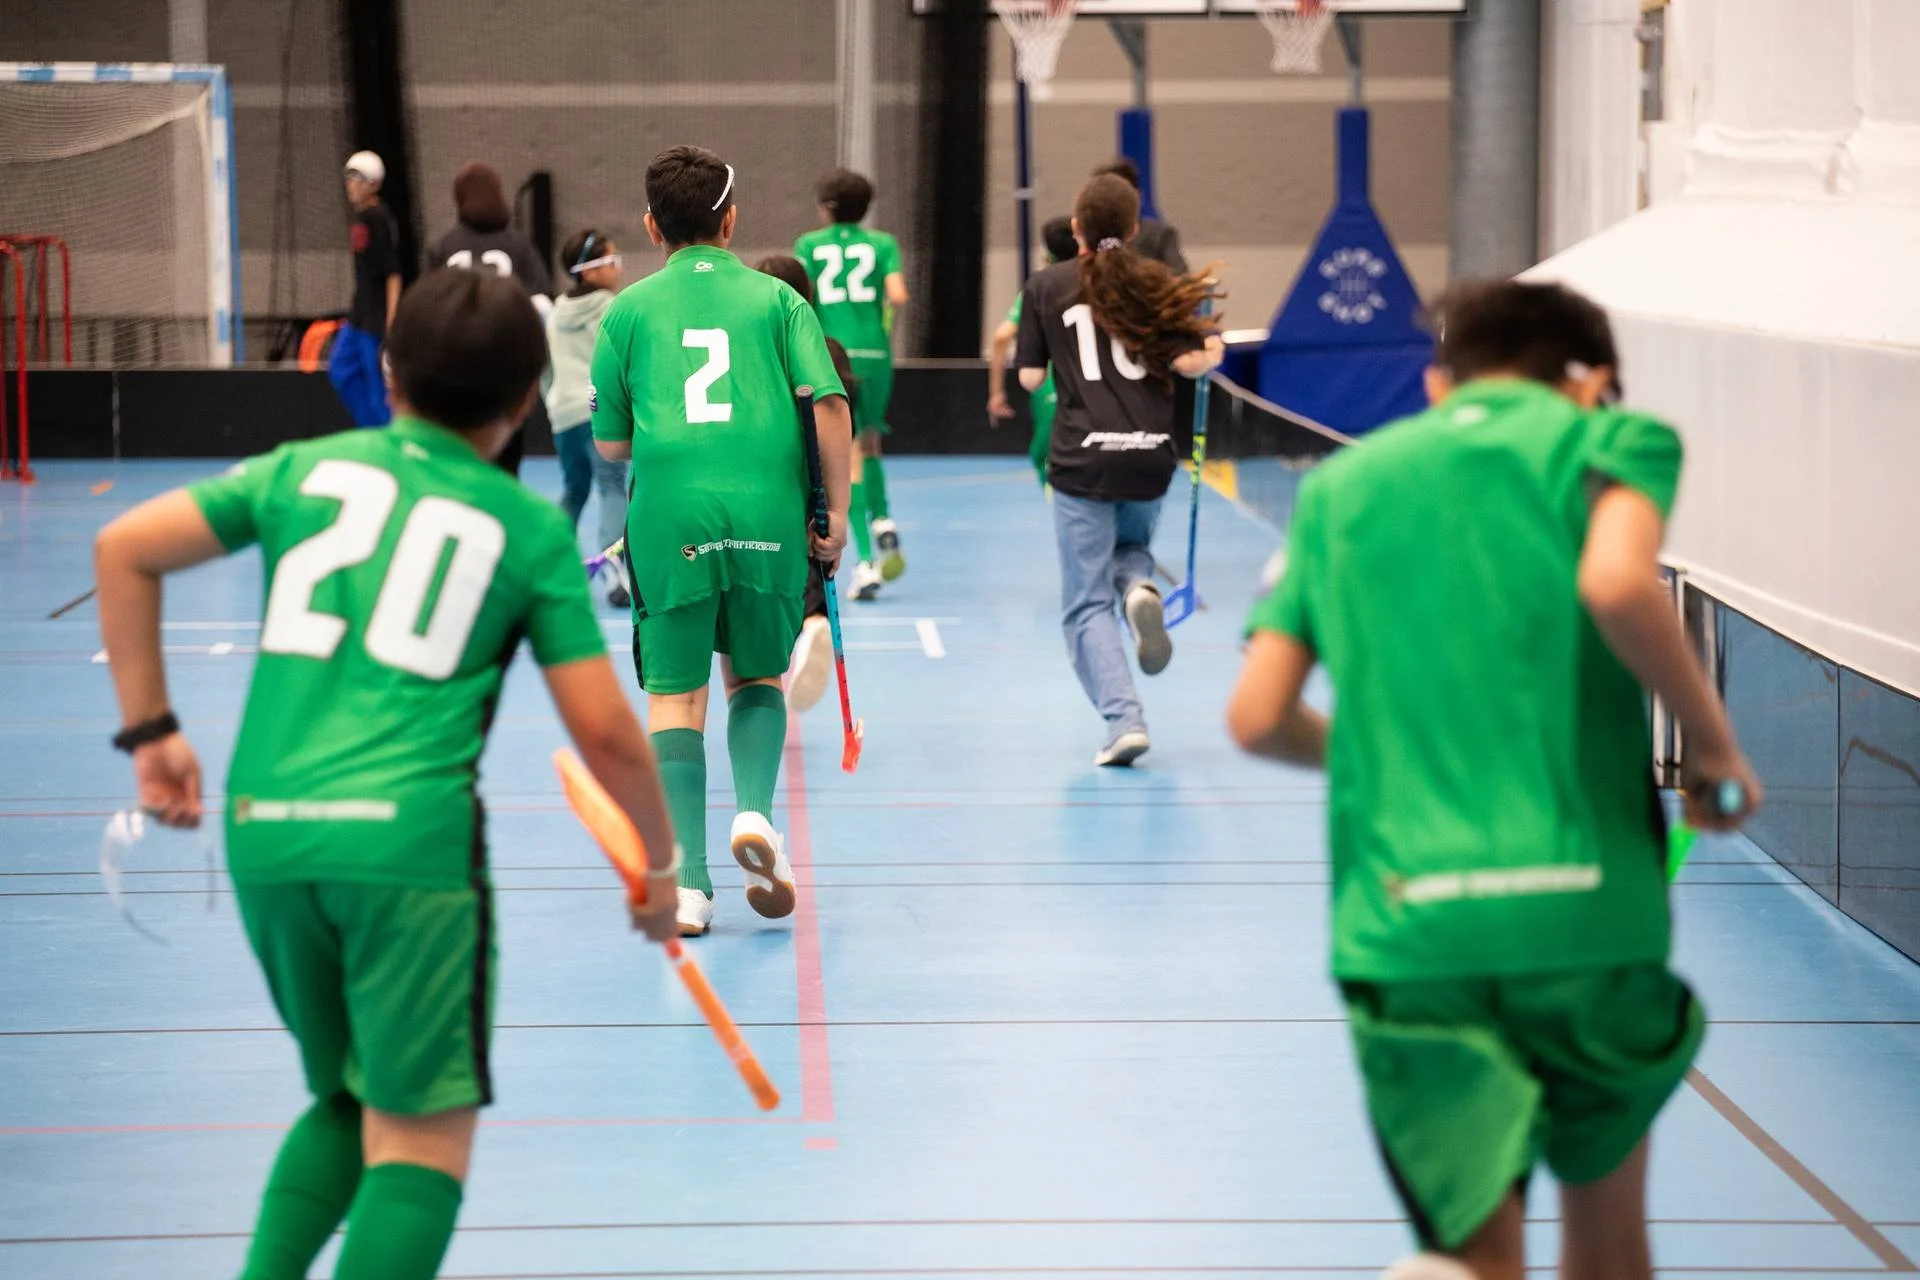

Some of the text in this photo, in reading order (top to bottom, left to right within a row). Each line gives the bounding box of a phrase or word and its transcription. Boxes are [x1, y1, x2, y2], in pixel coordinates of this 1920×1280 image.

[813, 243, 877, 305] 22
[682, 327, 732, 424] 2
[260, 458, 507, 681] 20
